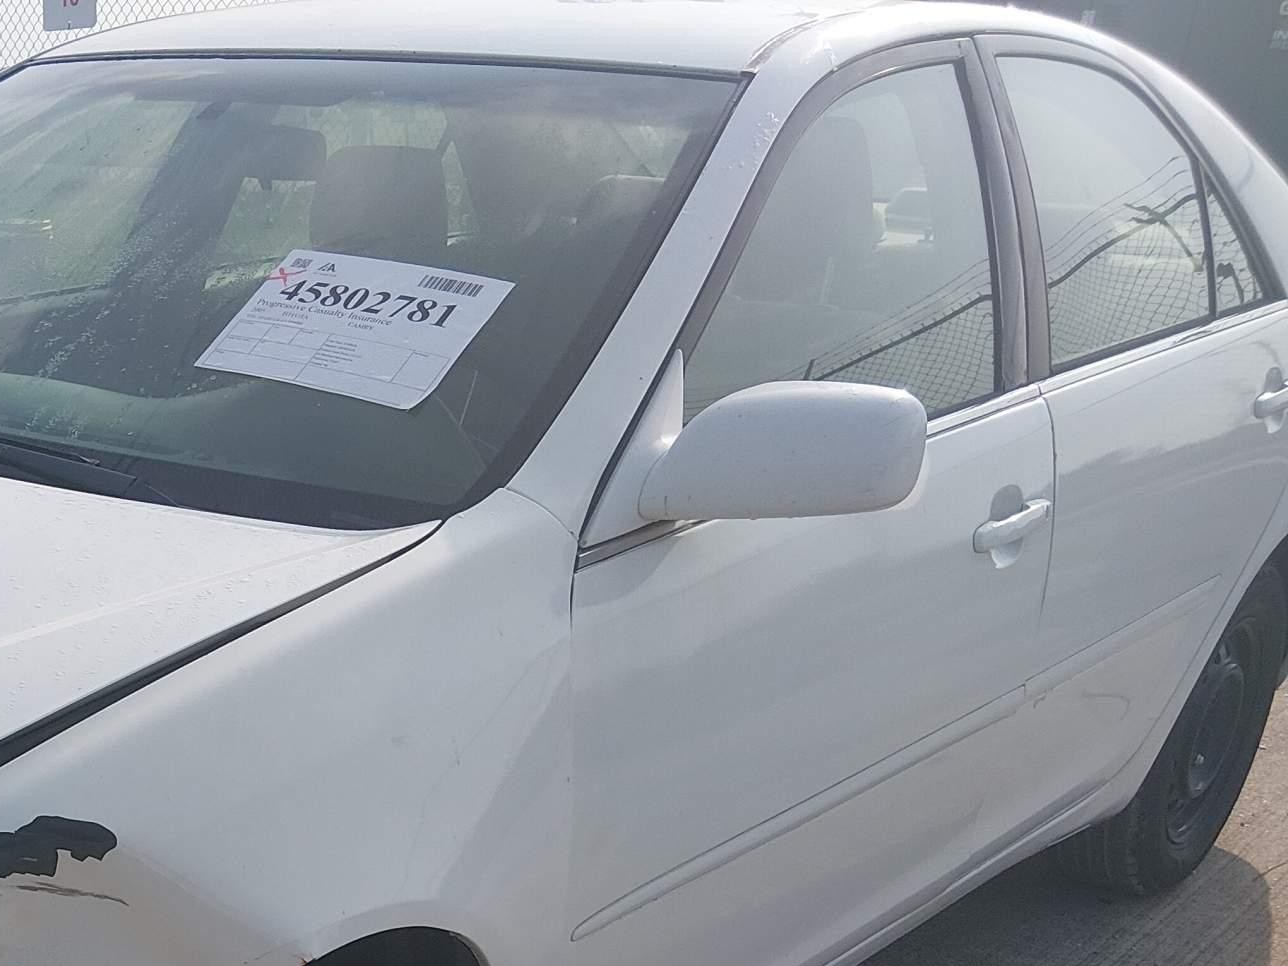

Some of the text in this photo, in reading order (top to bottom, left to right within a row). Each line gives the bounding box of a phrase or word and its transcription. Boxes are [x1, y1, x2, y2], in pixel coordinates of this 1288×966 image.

[257, 299, 307, 312] Progressive
[308, 305, 344, 319] Casualty
[347, 312, 392, 326] Insurance
[279, 279, 458, 329] 45802781
